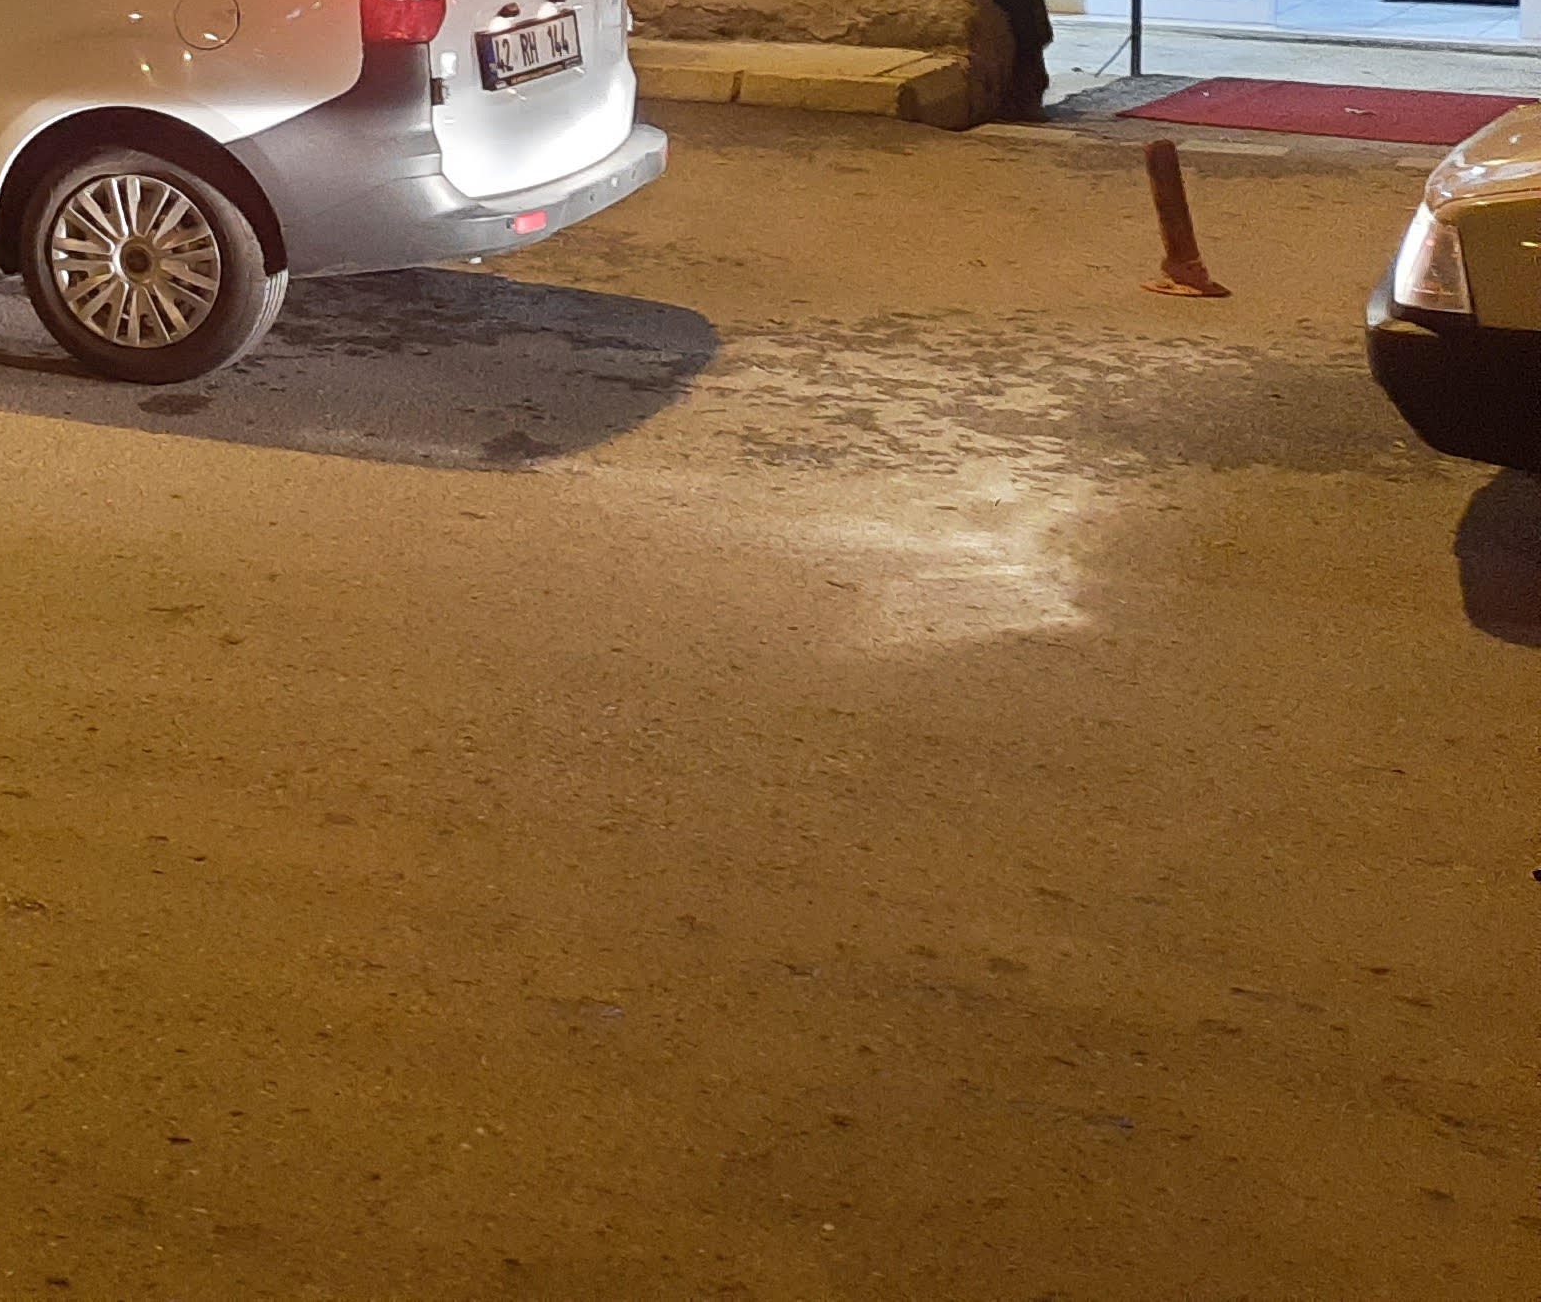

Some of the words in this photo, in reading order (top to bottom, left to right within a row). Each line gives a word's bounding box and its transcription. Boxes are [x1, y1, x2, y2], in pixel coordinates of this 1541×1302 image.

[495, 39, 514, 73] 42
[520, 31, 539, 66] RH
[547, 22, 569, 57] 144
